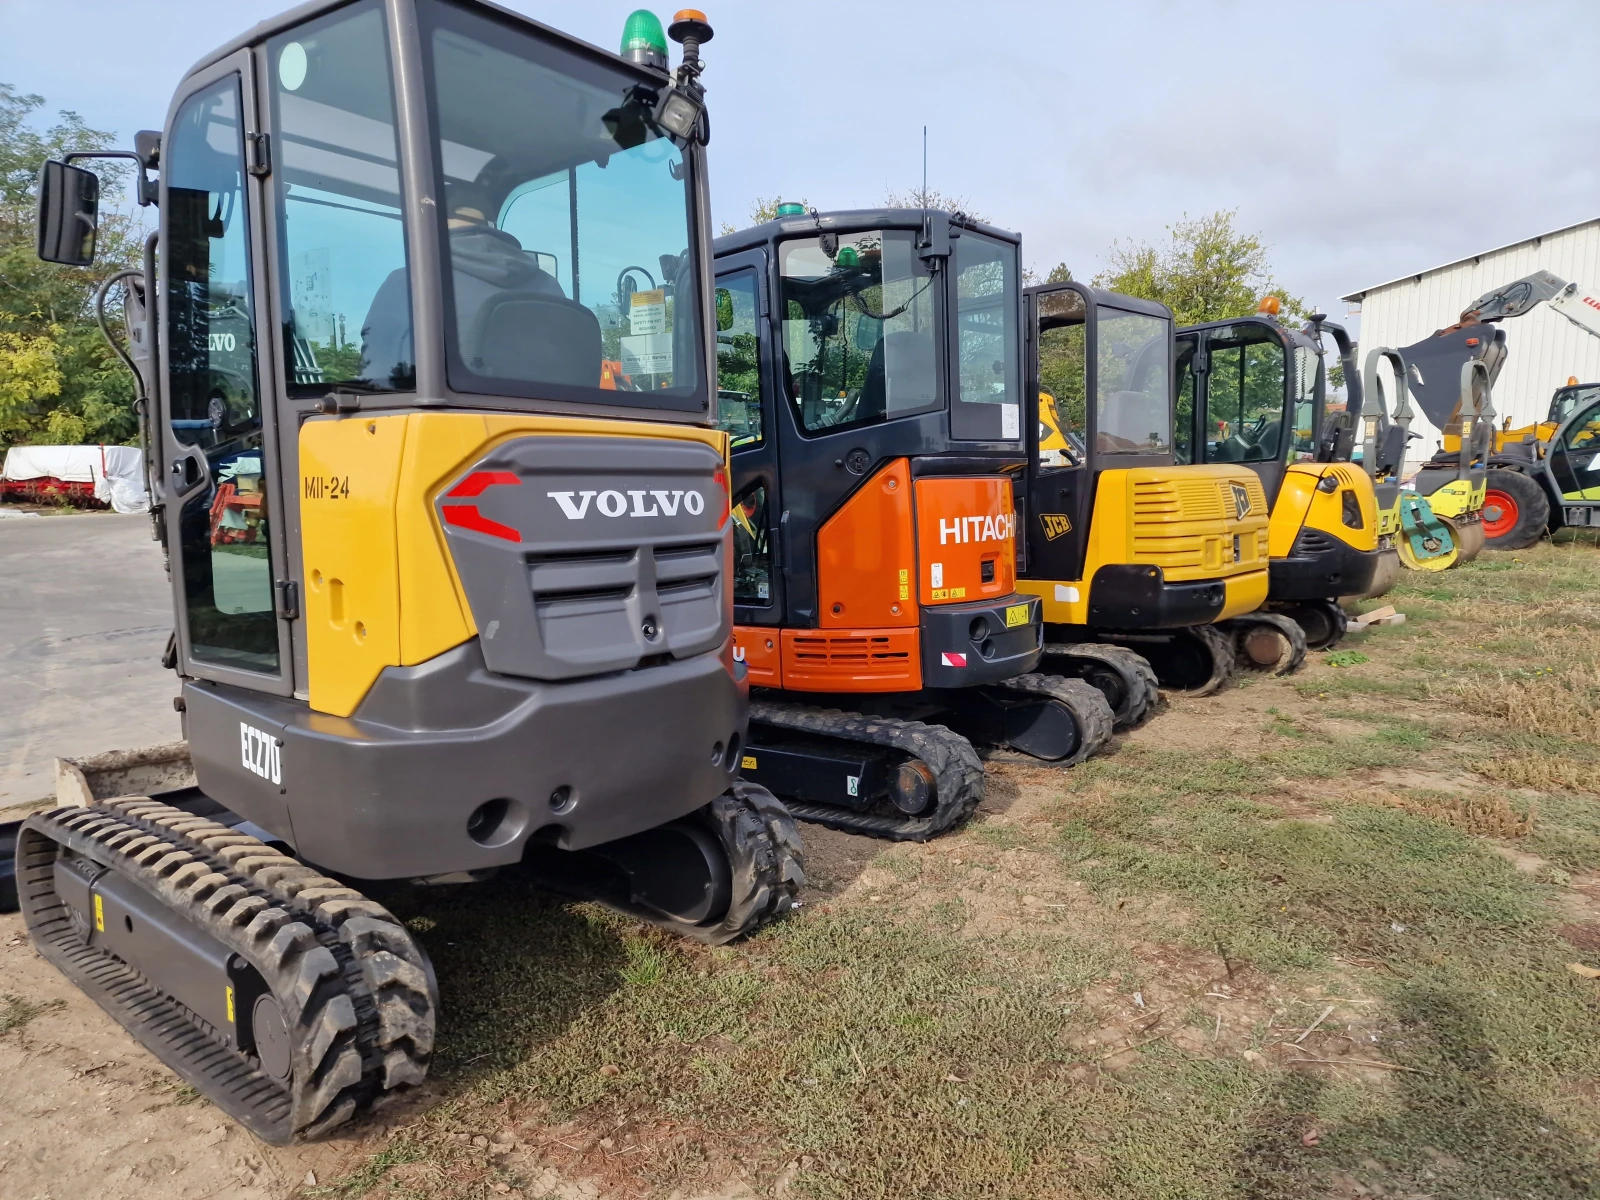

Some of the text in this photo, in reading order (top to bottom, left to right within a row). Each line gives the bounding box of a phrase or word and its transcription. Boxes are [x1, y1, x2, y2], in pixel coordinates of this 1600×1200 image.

[208, 333, 236, 352] LVO
[546, 489, 705, 520] VOLVO
[939, 513, 1016, 546] HITACHI
[1043, 515, 1070, 539] JCB
[240, 721, 281, 786] EC27D
